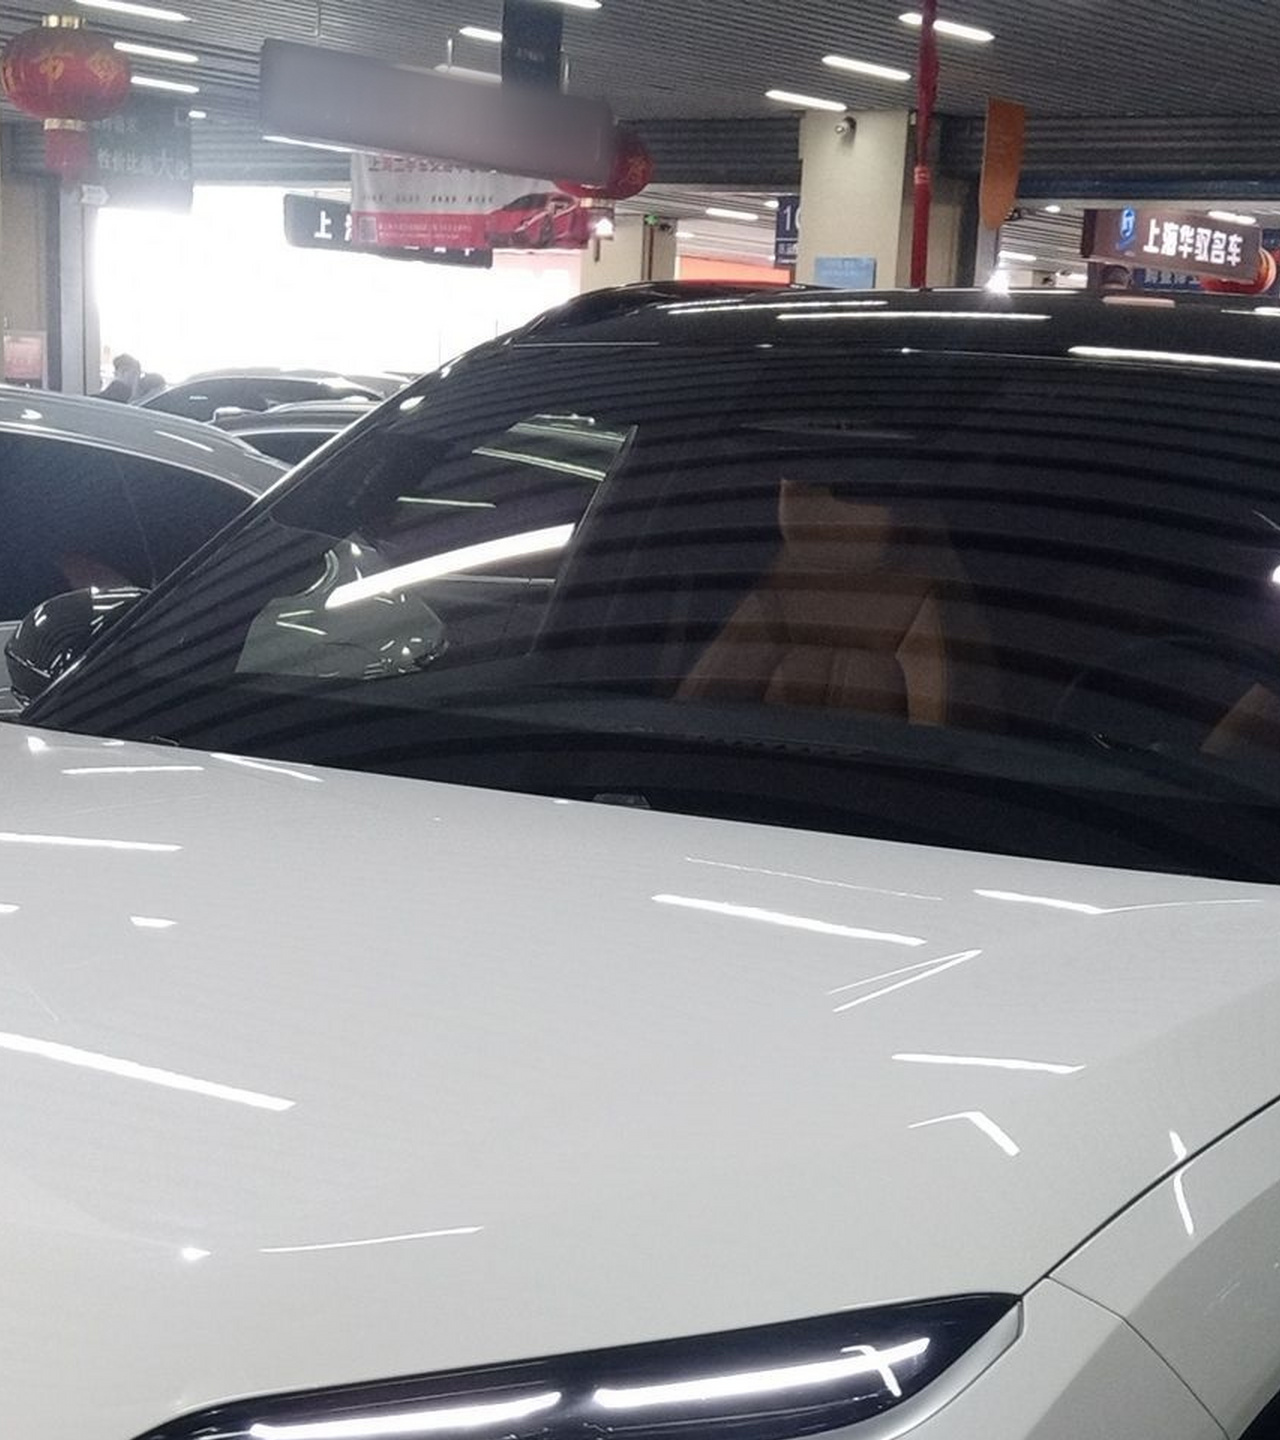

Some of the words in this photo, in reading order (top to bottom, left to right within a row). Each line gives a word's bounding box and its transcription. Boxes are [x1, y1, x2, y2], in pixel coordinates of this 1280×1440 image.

[1143, 218, 1244, 267] 上海华驭名车
